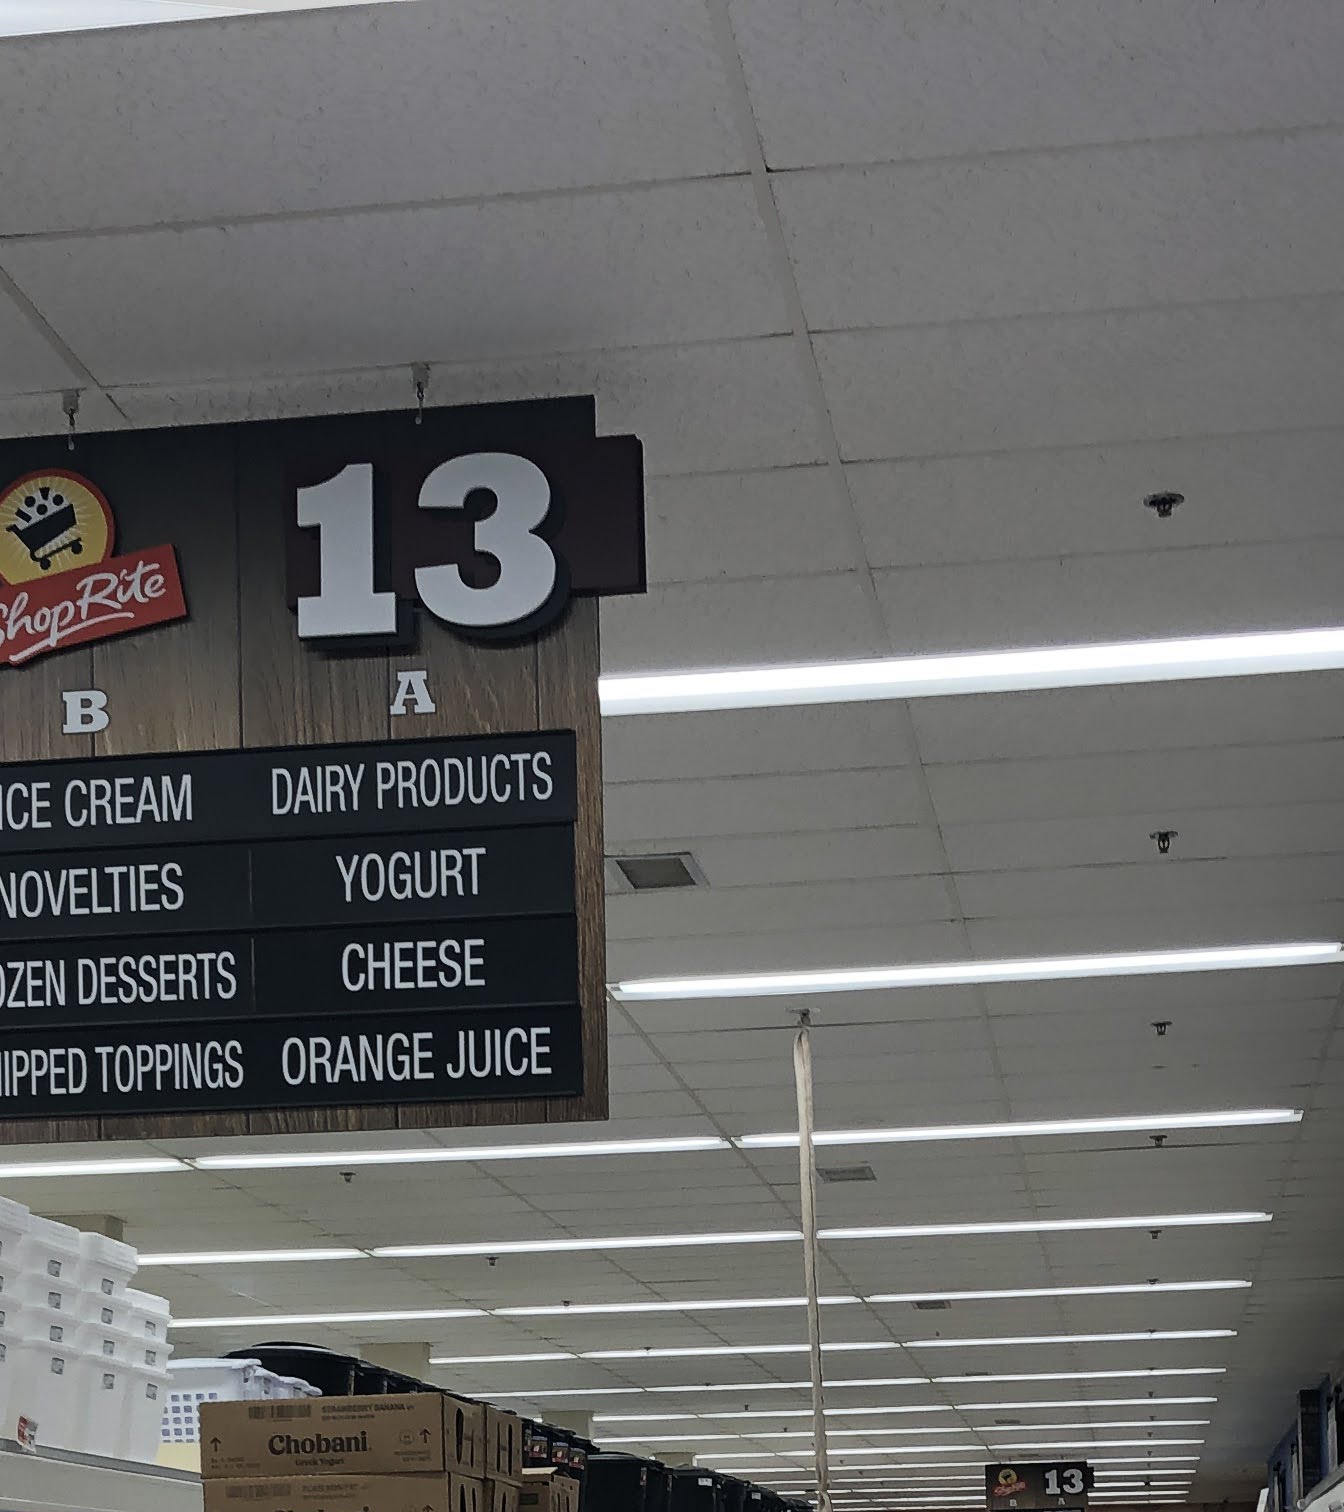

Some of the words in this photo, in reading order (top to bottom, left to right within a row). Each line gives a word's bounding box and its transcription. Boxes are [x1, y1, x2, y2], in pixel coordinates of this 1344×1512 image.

[295, 451, 556, 640] 13
[62, 690, 110, 735] B
[389, 670, 436, 716] A
[64, 774, 193, 829] CREAM
[271, 762, 367, 816] DAIRY
[375, 750, 553, 811] PRODUCTS
[335, 847, 487, 904] YOGURT
[77, 952, 237, 1006] DESSERTS
[341, 938, 486, 992] CHEESE
[94, 1041, 245, 1094] TOPPINGS
[281, 1031, 435, 1087] ORANGE
[446, 1027, 552, 1080] JUICE
[268, 1431, 368, 1456] Chobani
[1045, 1468, 1084, 1494] 13
